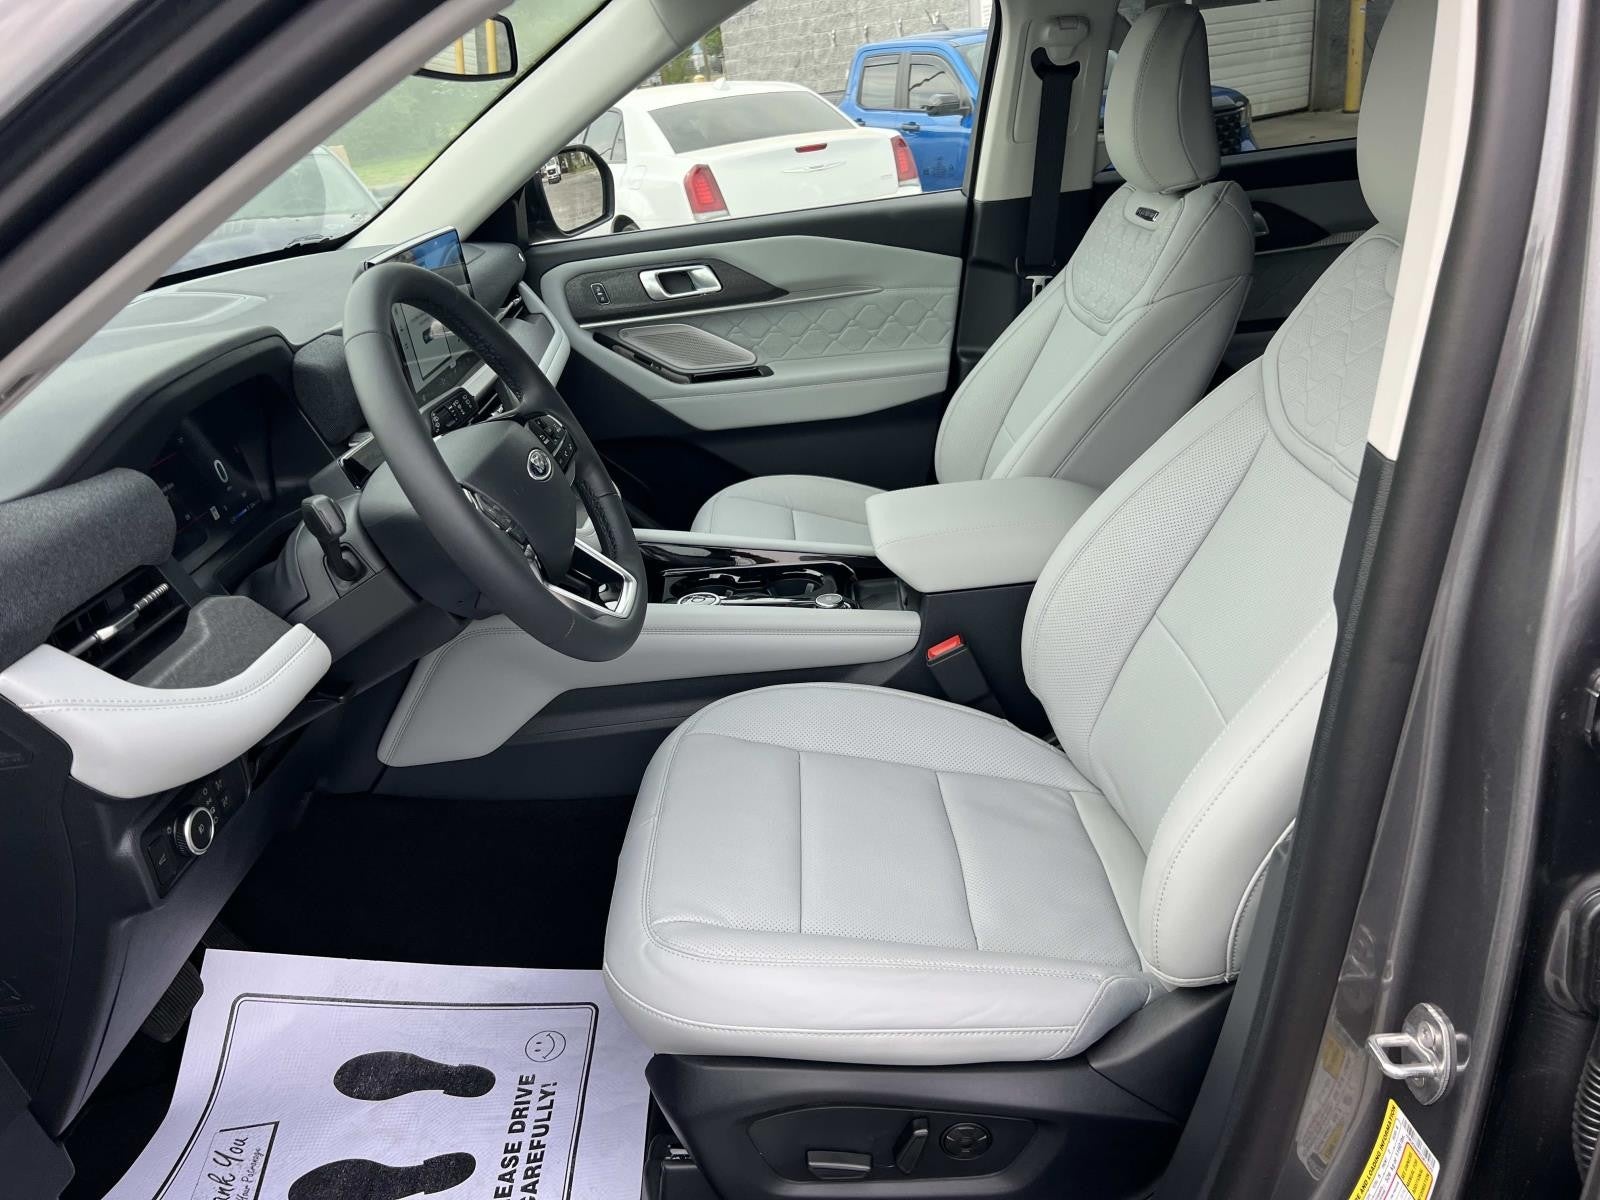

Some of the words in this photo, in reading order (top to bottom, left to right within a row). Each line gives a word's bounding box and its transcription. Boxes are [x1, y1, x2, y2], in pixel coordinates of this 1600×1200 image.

[213, 1137, 248, 1167] You
[494, 1141, 522, 1200] EASE
[508, 1074, 535, 1134] DRIVE
[1360, 1179, 1369, 1194] AND
[1367, 1152, 1381, 1180] LOADING
[1379, 1105, 1396, 1151] INFORMATION
